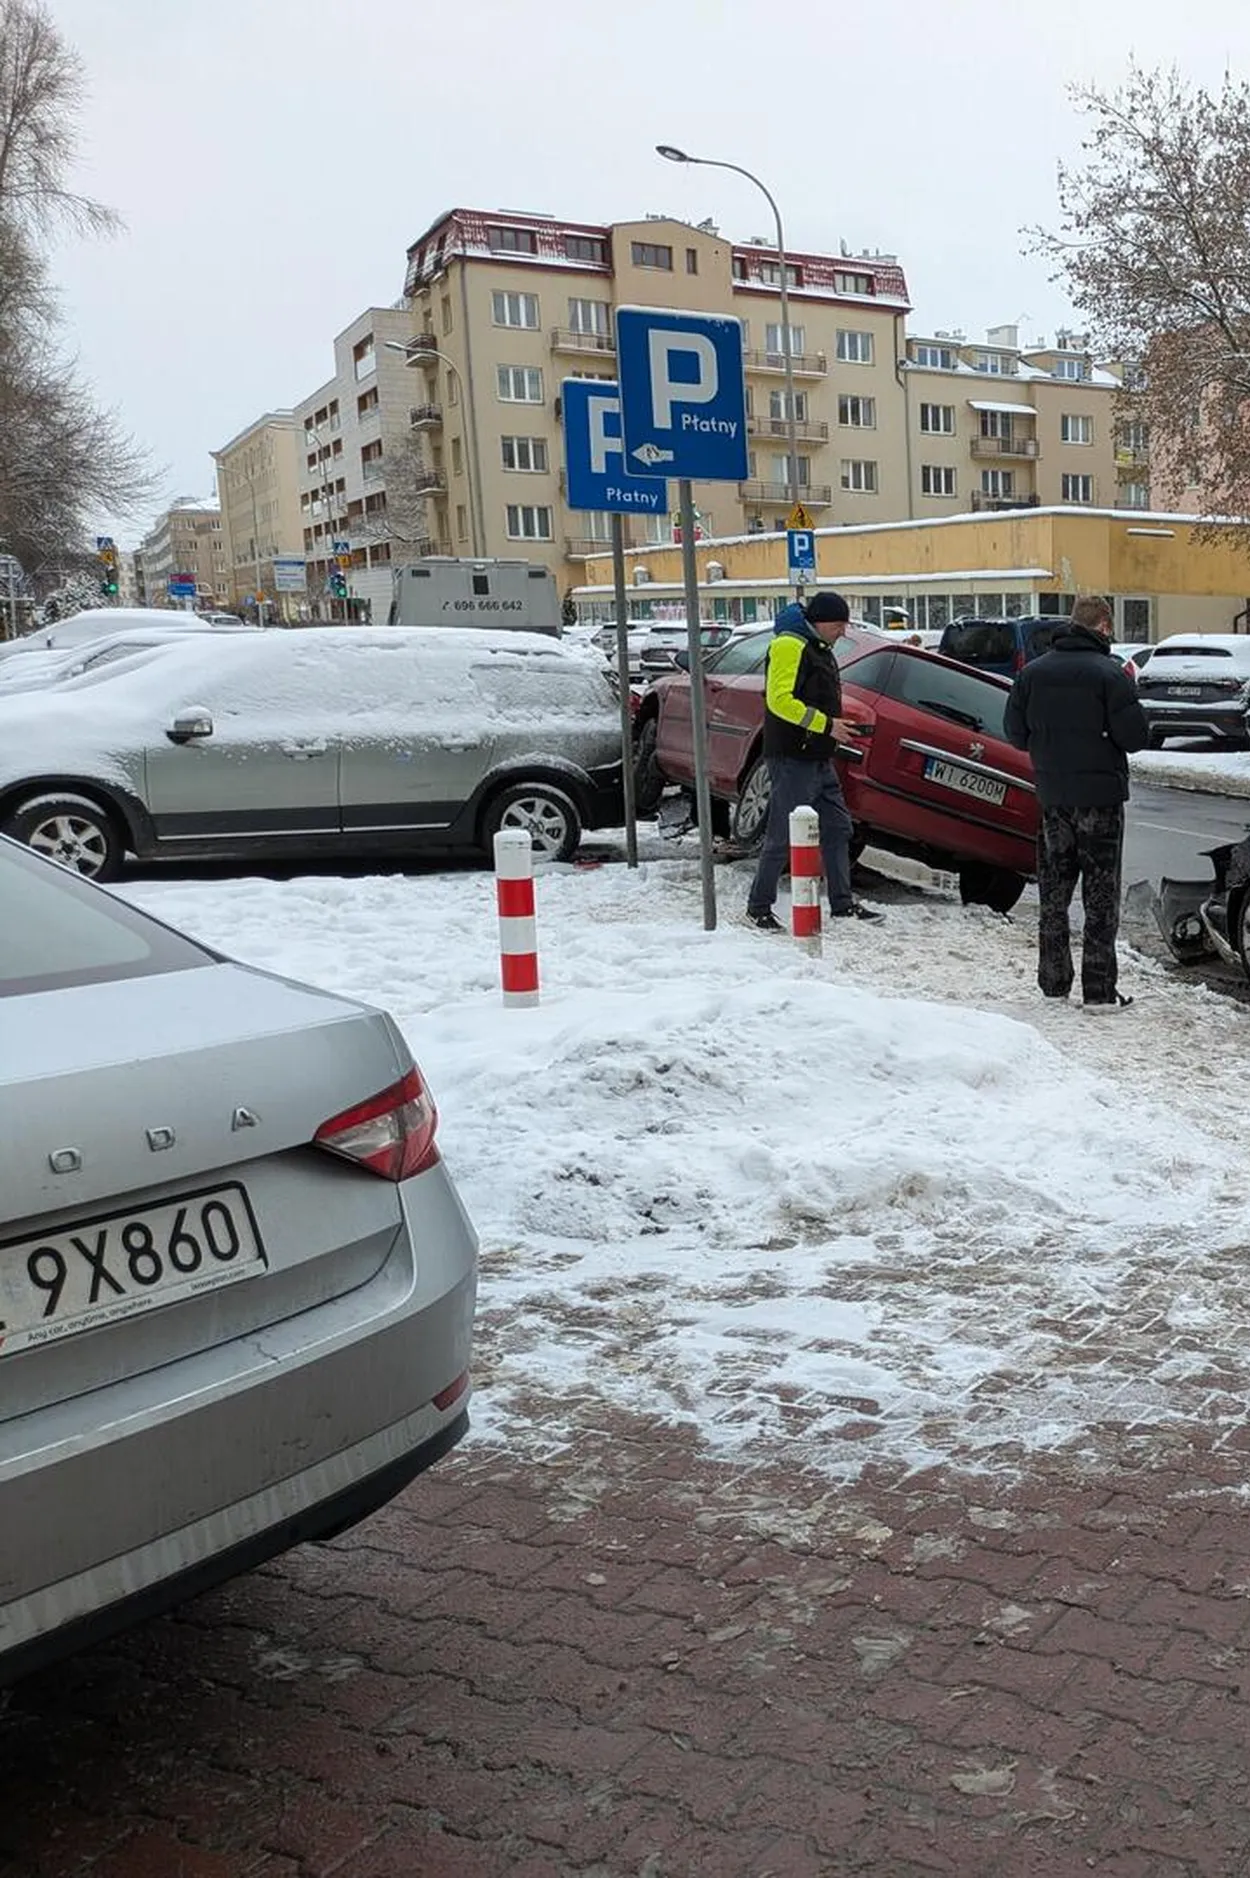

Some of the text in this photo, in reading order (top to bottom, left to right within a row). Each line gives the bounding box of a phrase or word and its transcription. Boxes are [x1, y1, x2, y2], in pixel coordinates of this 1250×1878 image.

[648, 328, 719, 430] P
[681, 413, 738, 439] Płatny
[606, 487, 659, 508] Płatny
[794, 533, 809, 557] P
[454, 600, 522, 611] 696 666 642
[933, 762, 1005, 800] WI 6200M
[27, 1200, 240, 1318] 9X860
[28, 1327, 48, 1343] Any
